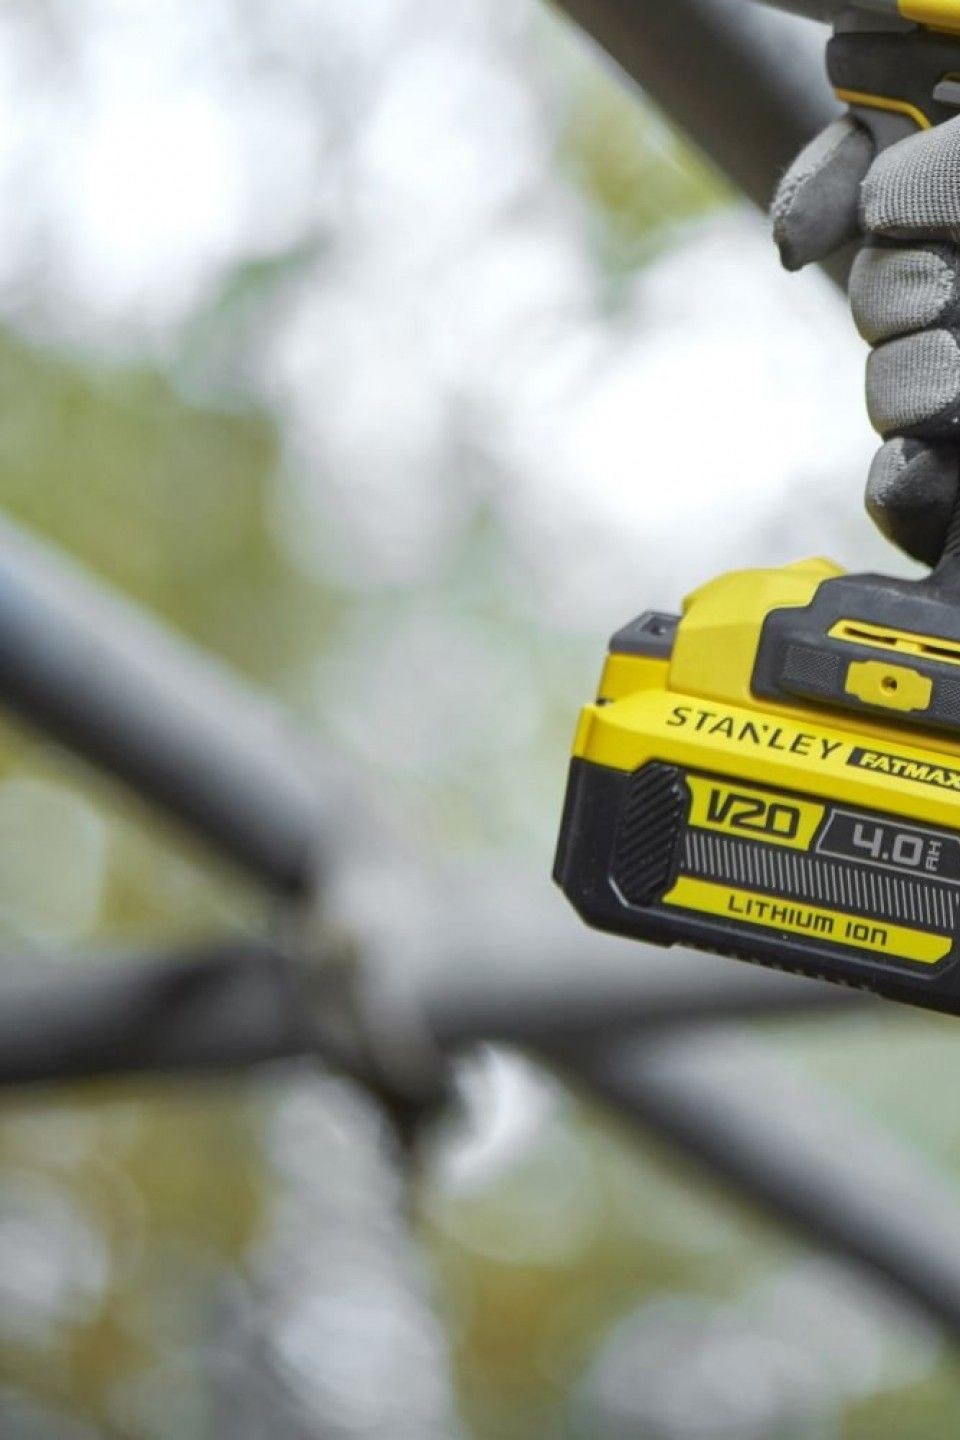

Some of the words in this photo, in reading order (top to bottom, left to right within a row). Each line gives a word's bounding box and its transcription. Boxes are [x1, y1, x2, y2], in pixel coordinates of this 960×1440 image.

[667, 706, 843, 760] STANLEY
[706, 789, 801, 839] V20
[853, 823, 924, 866] 4.0
[728, 895, 834, 934] LITHIUM
